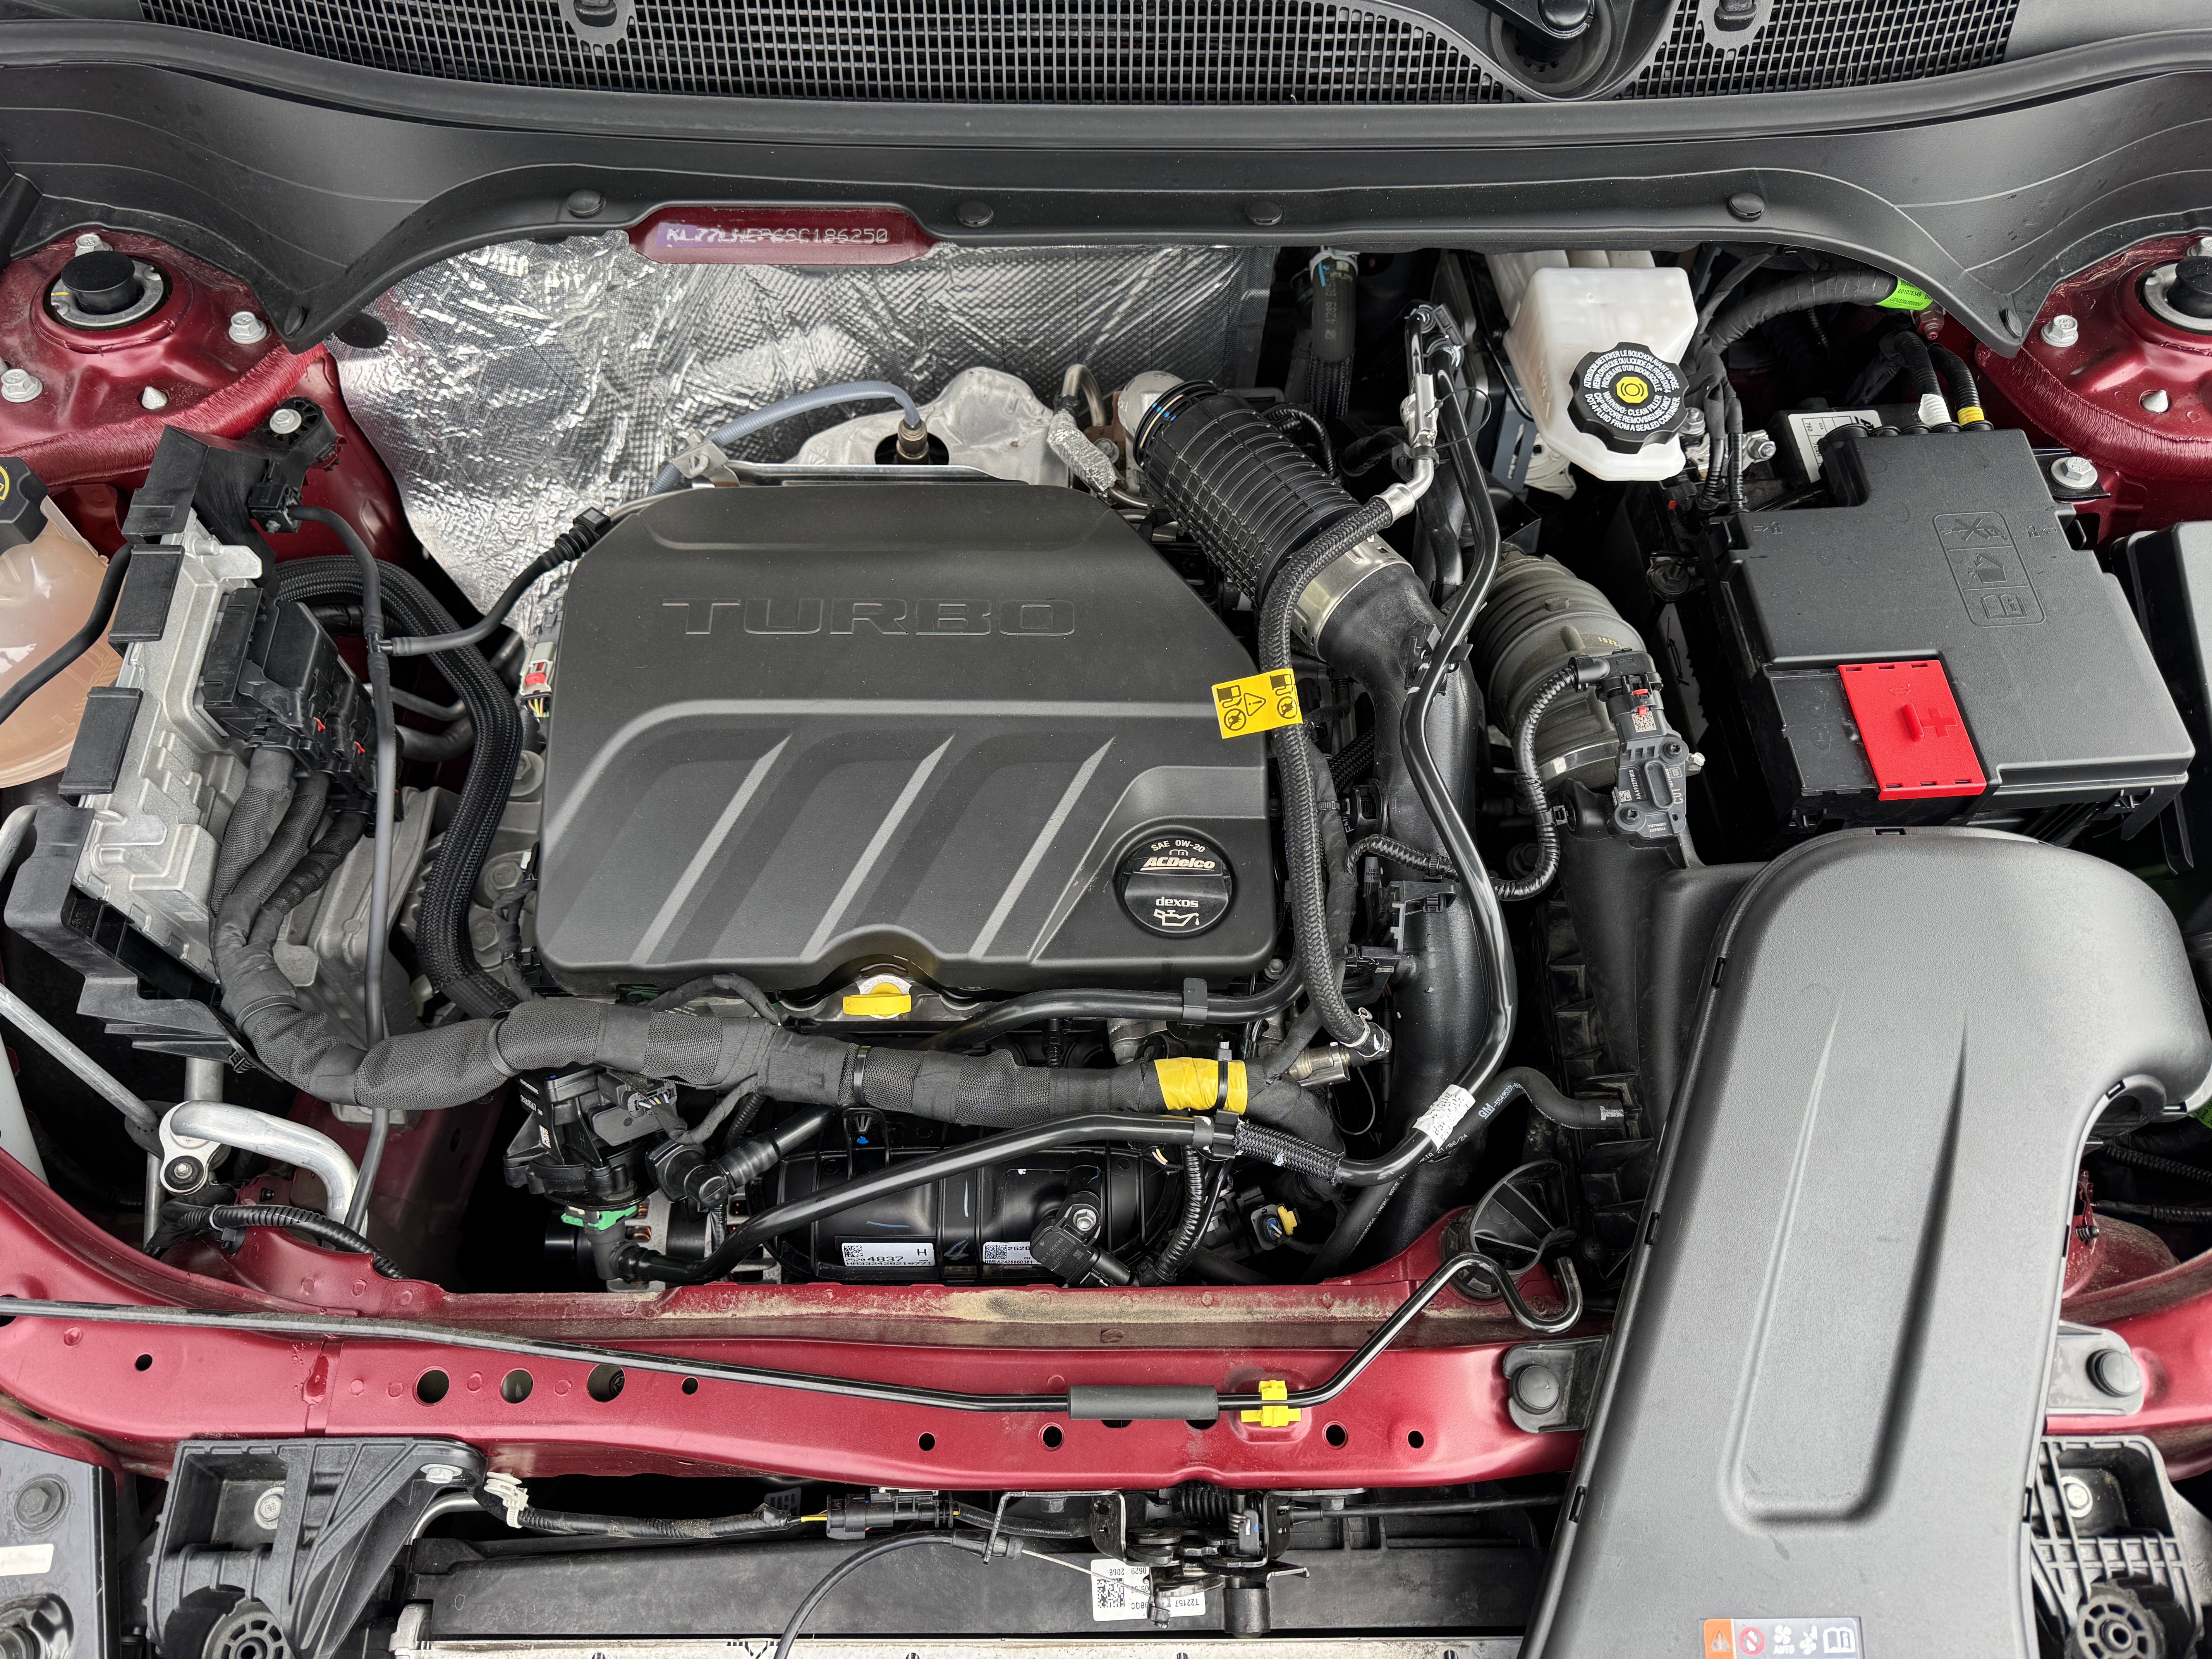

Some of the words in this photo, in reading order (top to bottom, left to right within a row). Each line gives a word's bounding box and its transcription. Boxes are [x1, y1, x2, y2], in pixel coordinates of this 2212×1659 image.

[1595, 350, 1620, 366] NETTOYER
[1628, 350, 1653, 362] BOUCHON
[1651, 357, 1669, 372] AVANT
[1609, 358, 1619, 368] QUE
[1627, 357, 1647, 366] LIQUIDE
[1650, 365, 1667, 381] FREIN
[1601, 366, 1622, 388] PROVENANT
[1634, 366, 1651, 377] BIDON
[1649, 372, 1662, 392] SCELLE
[1594, 393, 1606, 406] CAP
[1600, 403, 1623, 419] BEFORE
[1651, 407, 1661, 419] USE
[1659, 396, 1671, 410] ONLY
[1602, 391, 1627, 413] WARNING:
[1628, 407, 1649, 416] CLEAN
[1647, 395, 1662, 411] FILLER
[1594, 407, 1611, 423] FLUID
[1611, 419, 1630, 430] FROM
[1636, 420, 1660, 431] SEALED
[1805, 422, 1813, 432] 760
[663, 598, 1074, 635] TURBO
[1151, 840, 1170, 851] SAE
[1175, 840, 1206, 852] 0W-20
[1143, 857, 1215, 869] ACDelco
[1156, 896, 1199, 908] dexos
[1478, 1103, 1495, 1119] GM
[1388, 1182, 1400, 1195] MADE
[1175, 1599, 1199, 1607] T22157
[1773, 1645, 1795, 1654] AUTO
